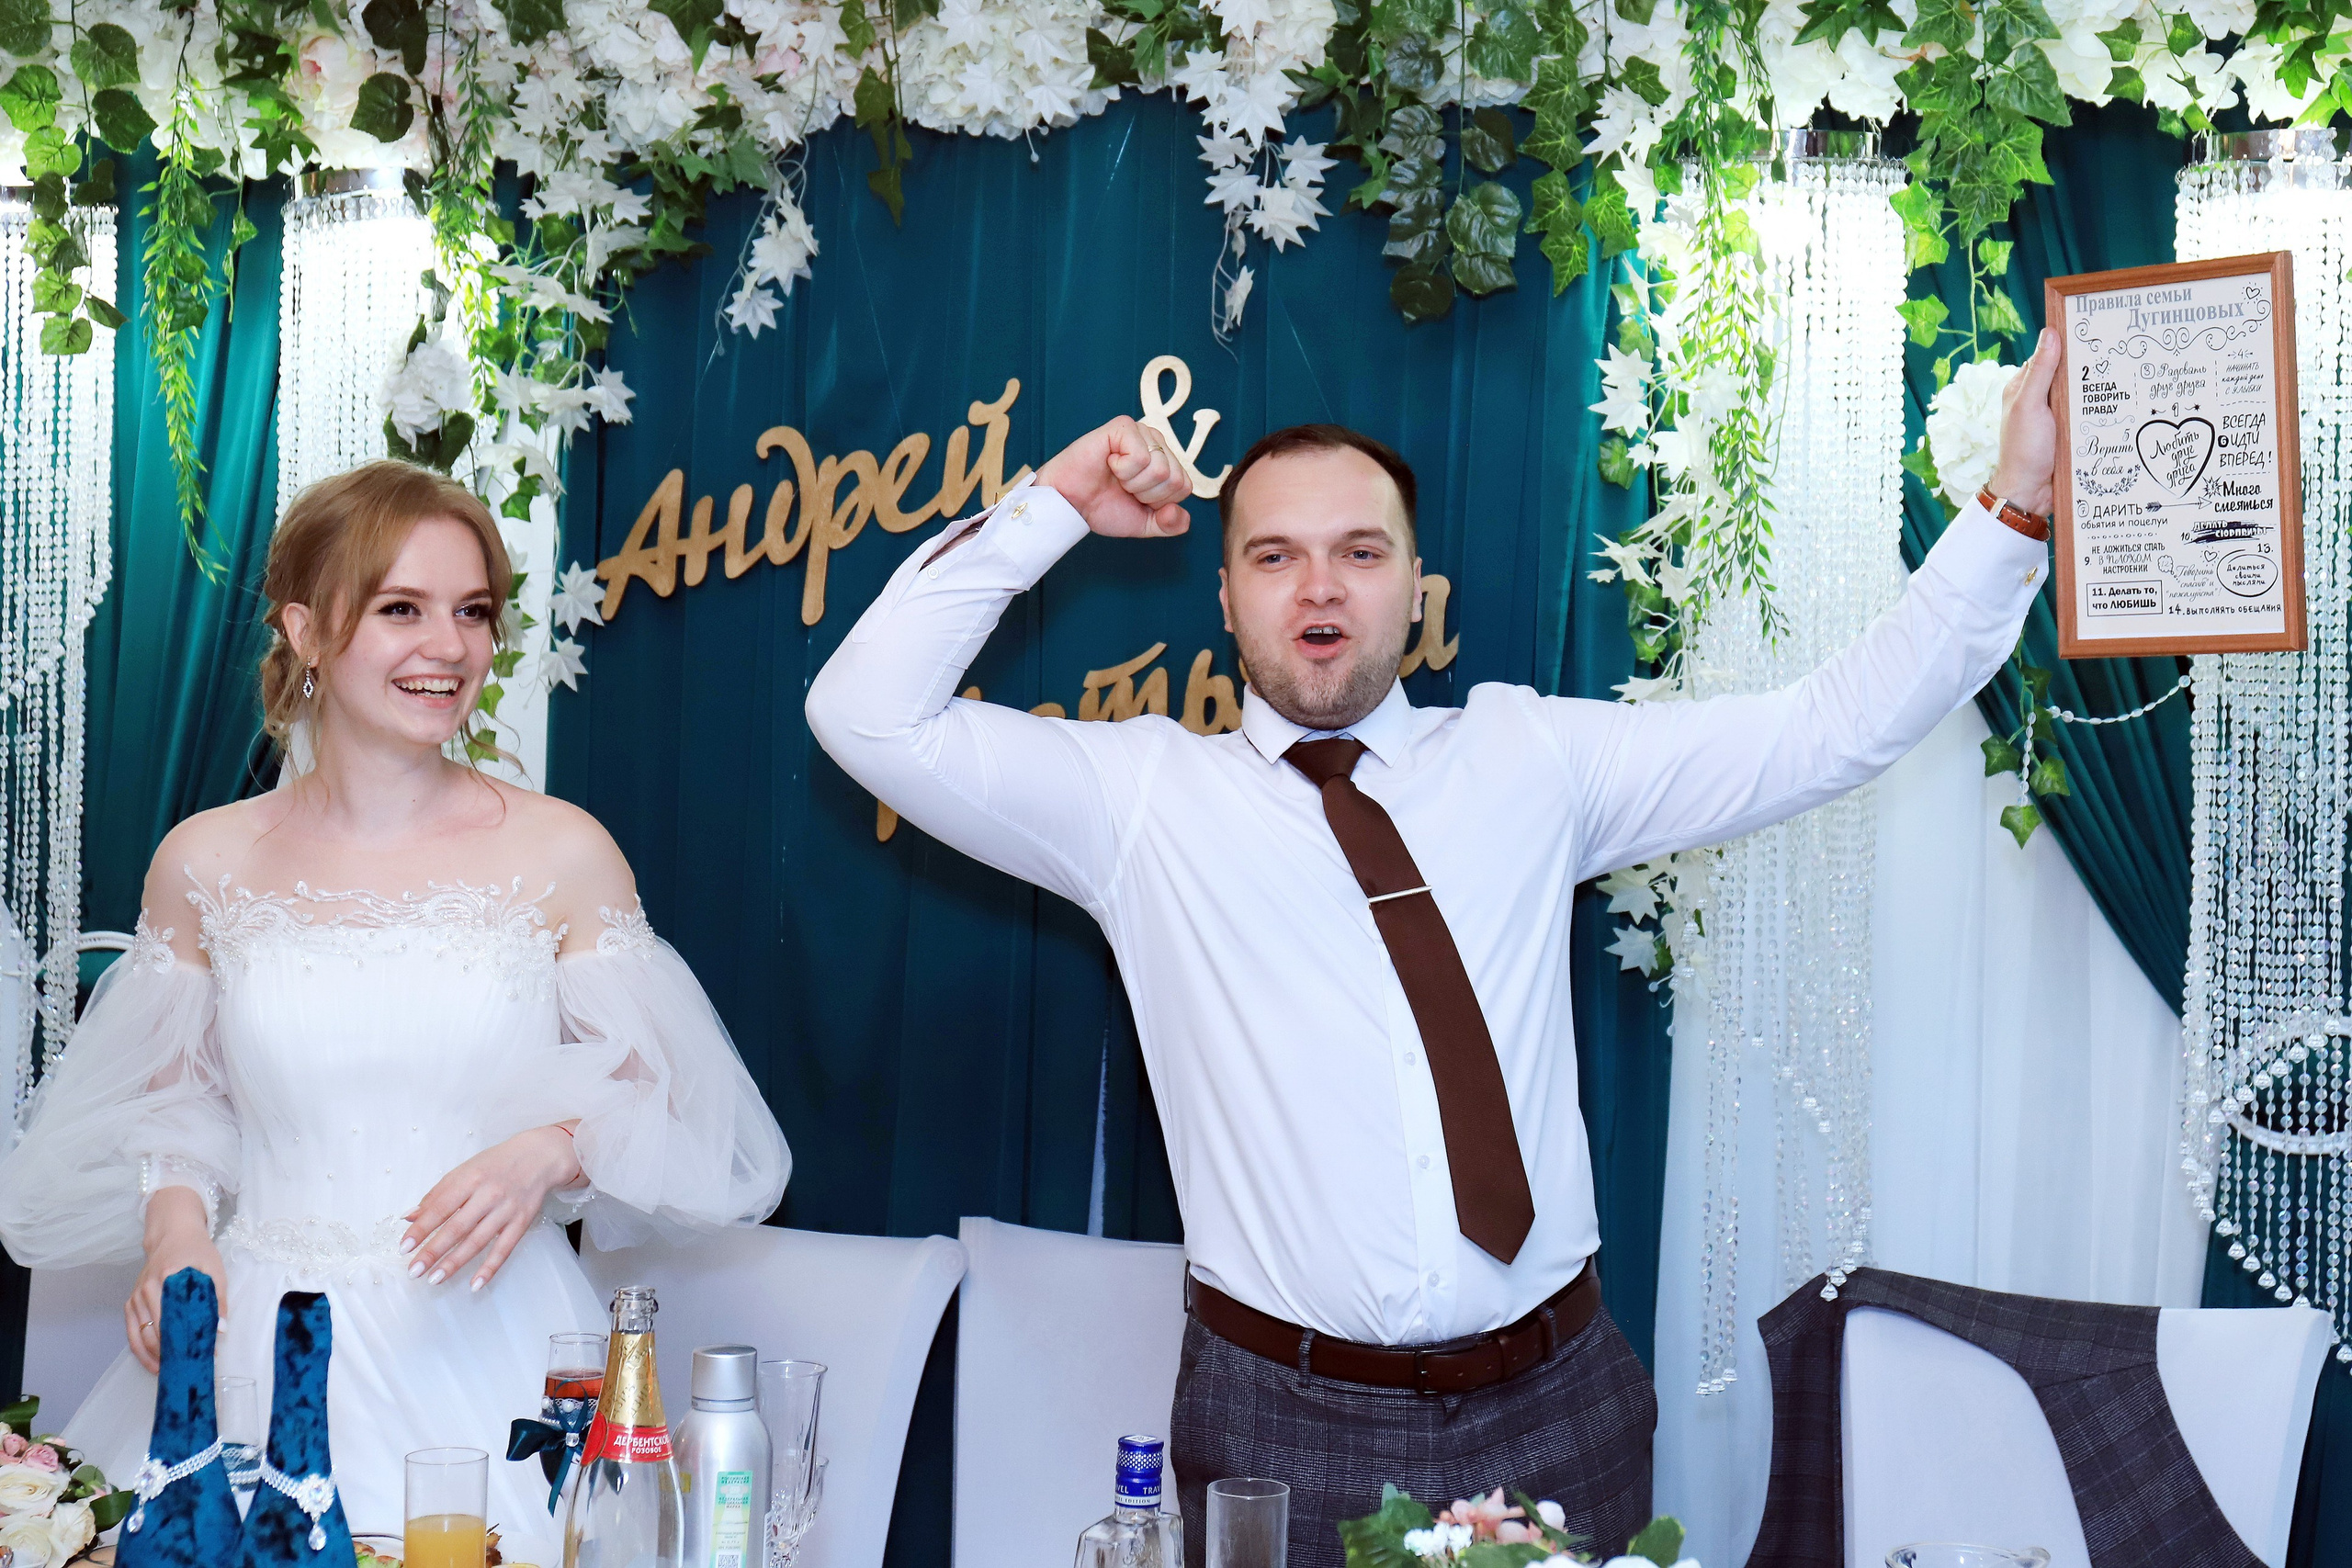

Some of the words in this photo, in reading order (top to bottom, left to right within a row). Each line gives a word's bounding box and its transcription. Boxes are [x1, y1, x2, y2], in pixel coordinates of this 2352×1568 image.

[2075, 292, 2143, 316] Правила
[2146, 288, 2192, 305] семьи
[2126, 302, 2245, 333] Дугинцовых
[2237, 348, 2244, 359] 4
[2082, 366, 2090, 381] 2
[2157, 361, 2207, 382] Радовать
[2226, 362, 2260, 373] НАЧИНАТЬ
[2082, 381, 2117, 392] ВСЕГДА
[2248, 374, 2264, 385] день
[2150, 382, 2174, 400] друг
[2176, 379, 2206, 397] друга
[2083, 391, 2131, 403] ГОВОРИТЬ
[2082, 404, 2119, 415] ПРАВДУ
[2222, 412, 2266, 432] ВСЕГДА
[2122, 428, 2131, 442] 5
[2231, 431, 2259, 451] ИДТИ
[2076, 434, 2134, 457] Верить
[2150, 431, 2199, 459] Любить
[2171, 445, 2199, 469] друг
[2102, 456, 2124, 475] себя
[2166, 463, 2196, 489] друга
[2222, 480, 2262, 497] Много
[596, 378, 1035, 626] Андрей
[2214, 498, 2274, 513] смеяться
[2093, 503, 2143, 519] ДАРИТЬ
[2128, 517, 2168, 528] поцелуи
[2192, 520, 2228, 531] ДЕЛАТЬ
[2091, 546, 2100, 554] НЕ
[2103, 543, 2142, 554] ЛОЖИТЬСЯ
[2144, 542, 2165, 551] СПАТЬ
[2098, 556, 2104, 565] В
[2106, 553, 2153, 565] ПЛОХОМ
[2103, 564, 2148, 574] НАСТРОЕНИИ
[2226, 564, 2266, 572] Делиться
[2092, 588, 2107, 596] 11.
[2109, 587, 2142, 597] Делать
[2143, 587, 2157, 595] то,
[2110, 599, 2156, 609] ЛЮБИШЬ
[2238, 604, 2281, 614] ОБЕЩАНИЯ
[614, 1434, 670, 1447] ДЕРБЕНТСКОЕ
